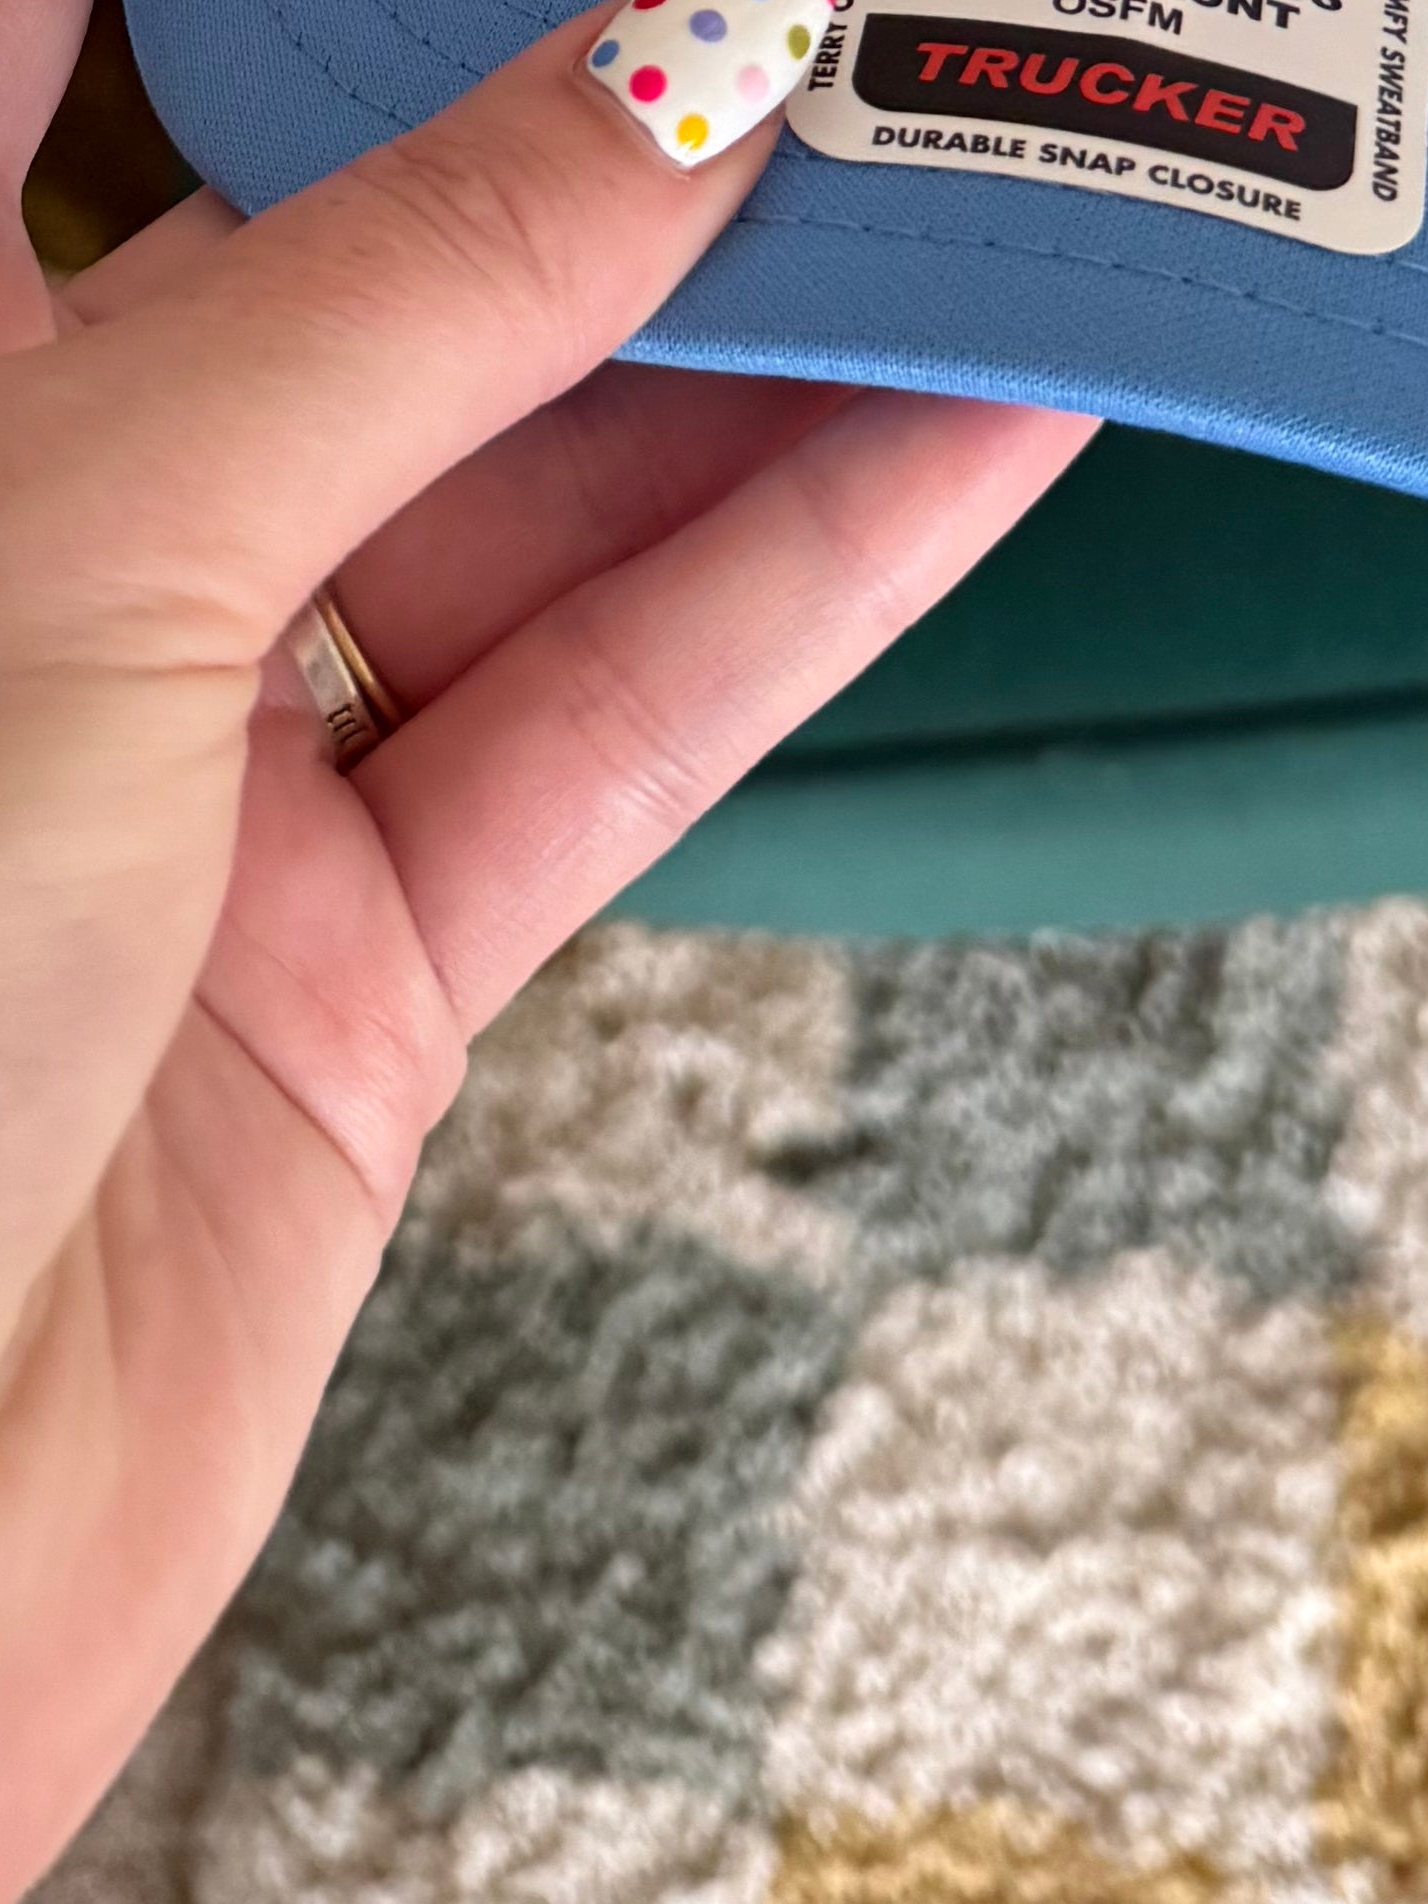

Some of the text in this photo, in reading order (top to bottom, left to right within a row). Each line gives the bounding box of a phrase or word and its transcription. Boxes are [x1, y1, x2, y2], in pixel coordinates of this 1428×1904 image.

[808, 22, 848, 91] TERRY
[916, 41, 1307, 152] TRUCKER
[872, 125, 1303, 222] DURABLE SNAP CLOSURE
[1371, 46, 1407, 203] SWEATBAND
